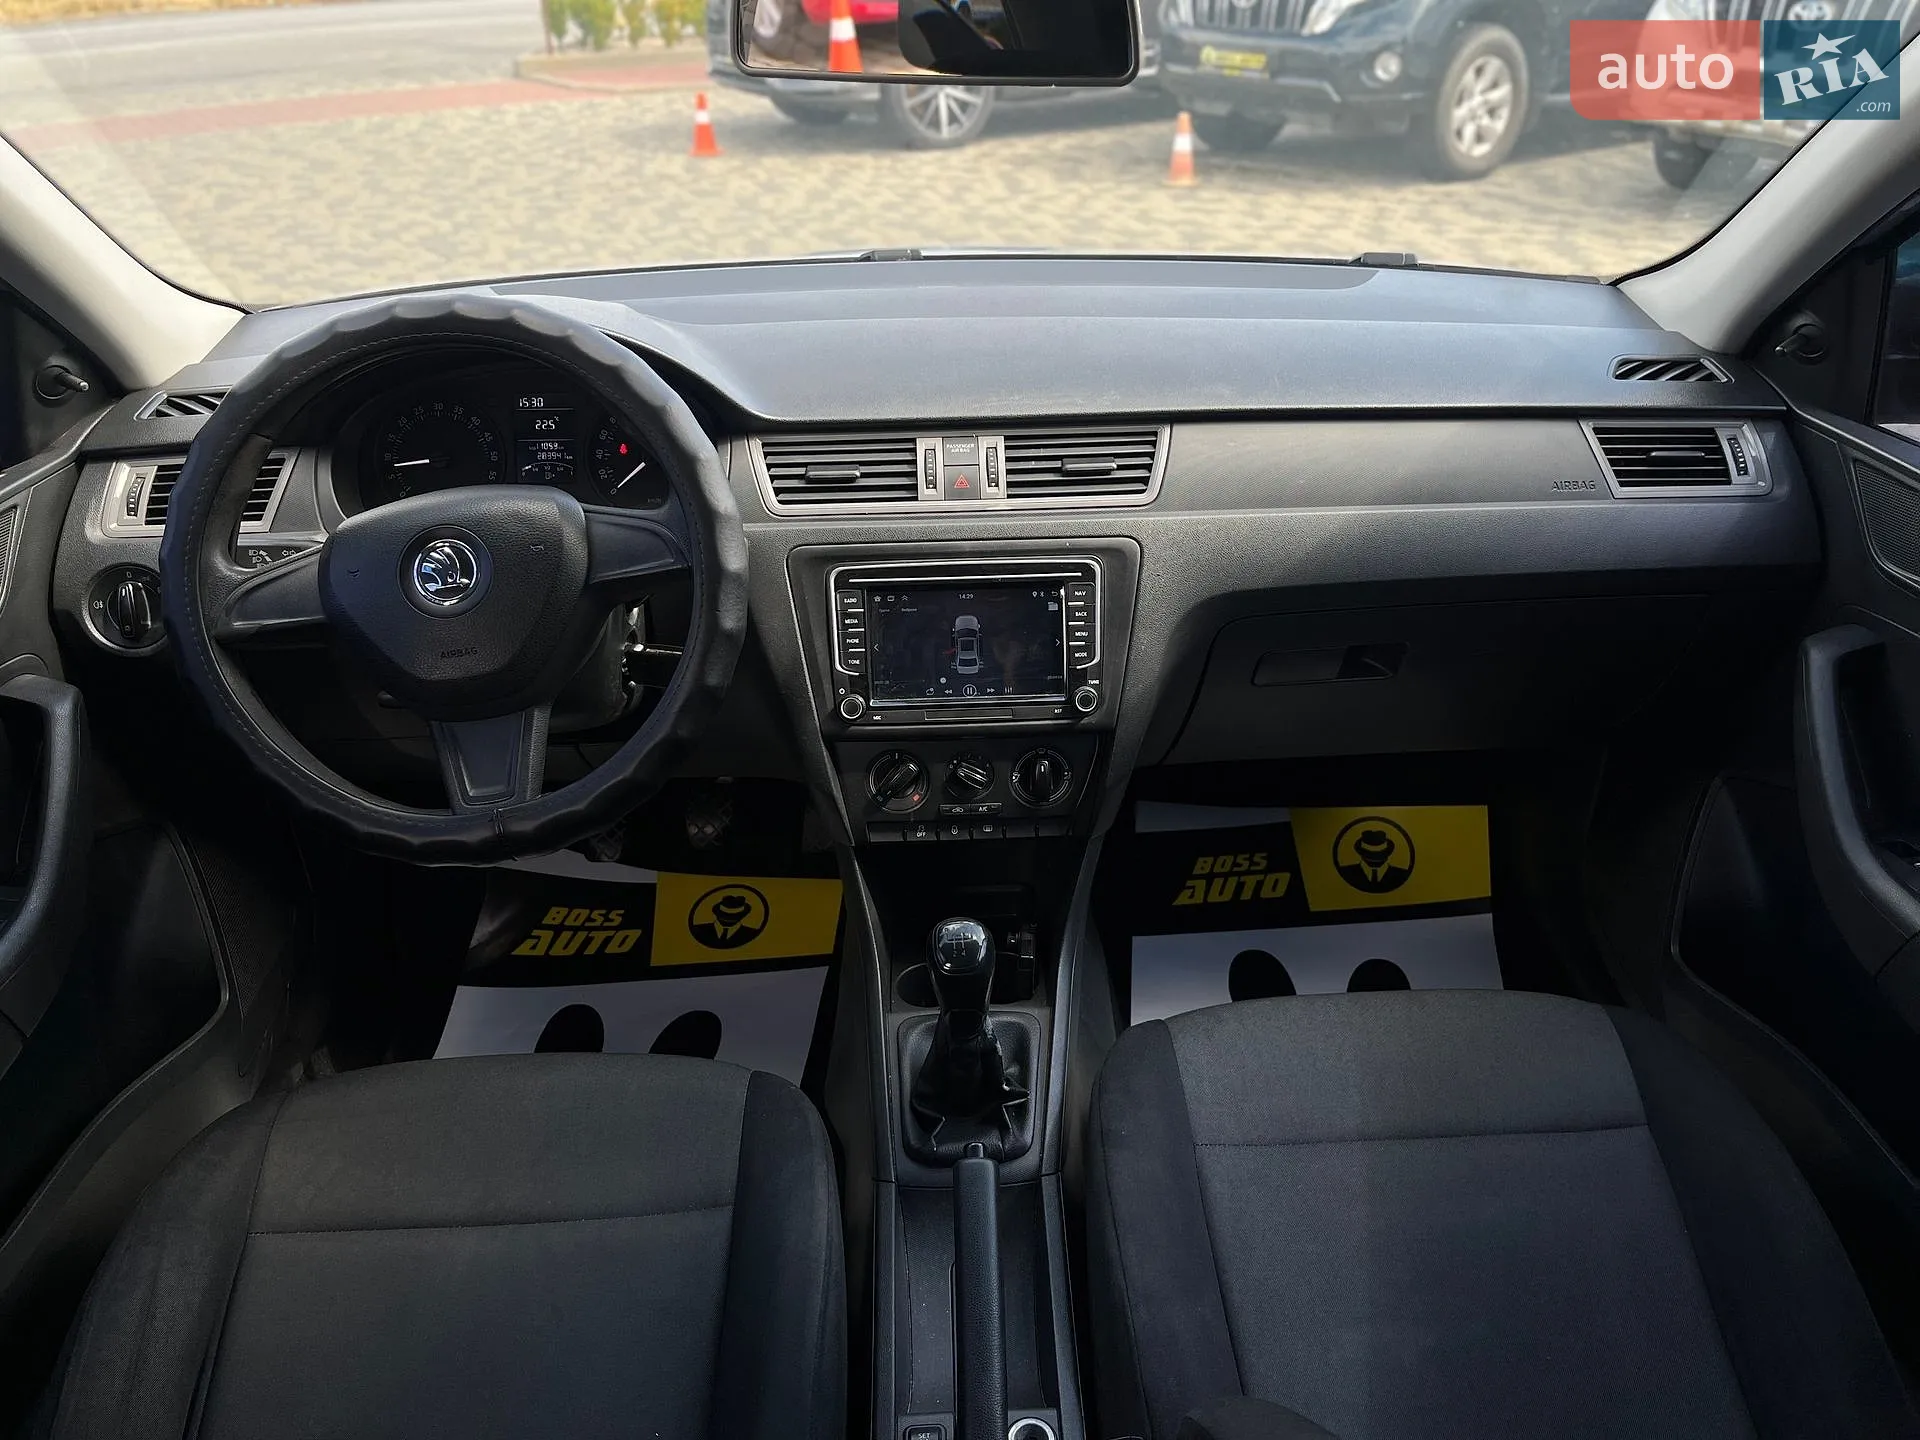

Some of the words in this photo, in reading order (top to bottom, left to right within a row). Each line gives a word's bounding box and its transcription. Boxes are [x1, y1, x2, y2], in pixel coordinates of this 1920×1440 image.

[432, 402, 444, 411] 30
[519, 397, 544, 408] 15:30
[453, 405, 465, 415] 35
[470, 415, 481, 427] 40
[488, 469, 497, 481] 55
[1552, 480, 1596, 491] AIRBAG
[440, 646, 478, 660] AIRBAG
[1193, 852, 1268, 875] BOSS
[1172, 872, 1291, 906] AUTO
[542, 906, 625, 927] BOSS
[511, 929, 642, 956] AUTO
